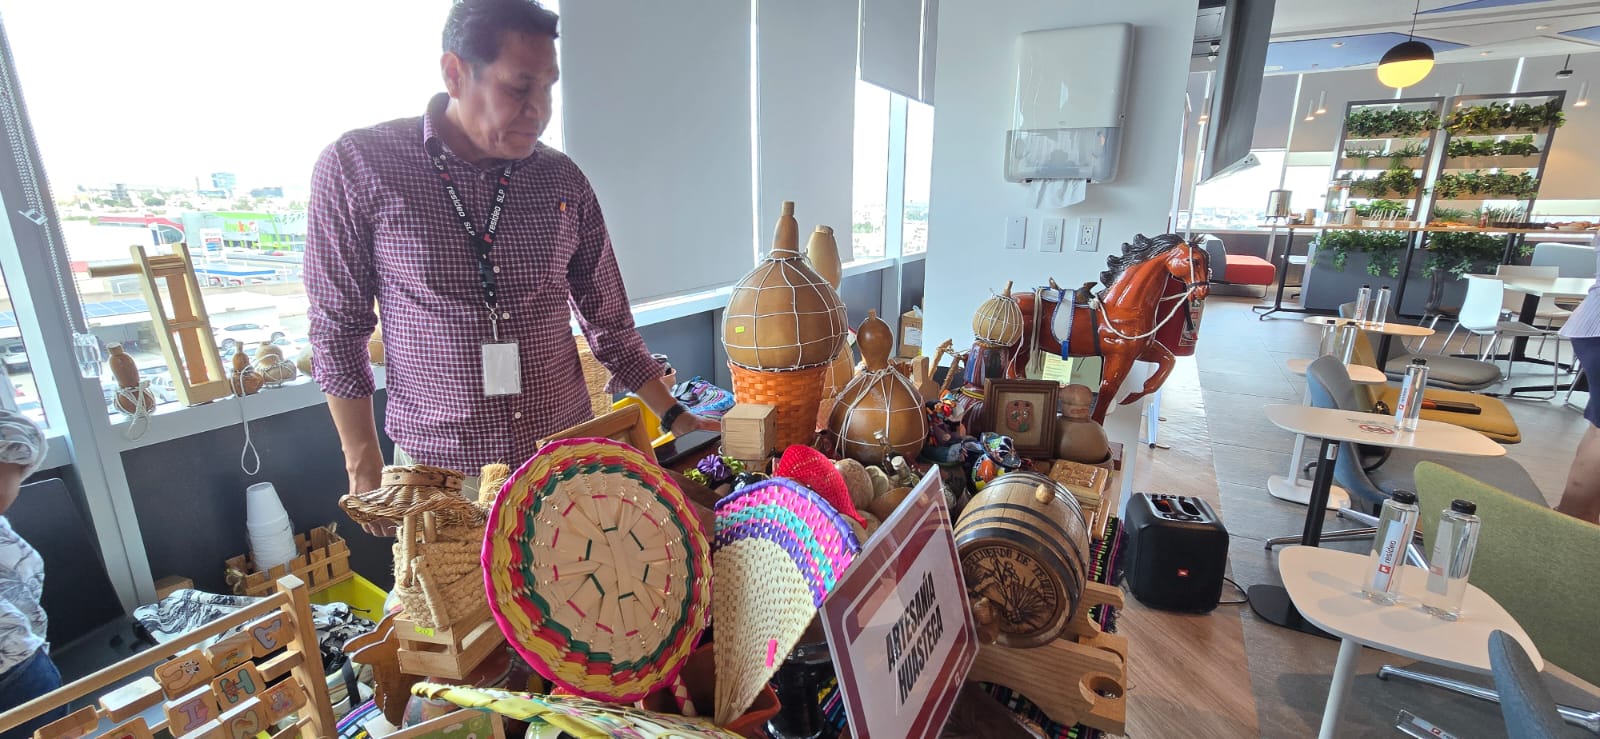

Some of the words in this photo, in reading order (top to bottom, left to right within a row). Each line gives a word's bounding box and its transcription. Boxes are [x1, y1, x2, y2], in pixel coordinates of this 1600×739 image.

[446, 186, 465, 217] resideo
[463, 221, 475, 236] SLP
[488, 206, 501, 234] resideo
[496, 189, 505, 203] SLP
[1016, 552, 1031, 567] DE
[1384, 540, 1397, 564] resideo
[885, 570, 936, 674] ARTESANÍA
[898, 604, 944, 706] HUASTECA
